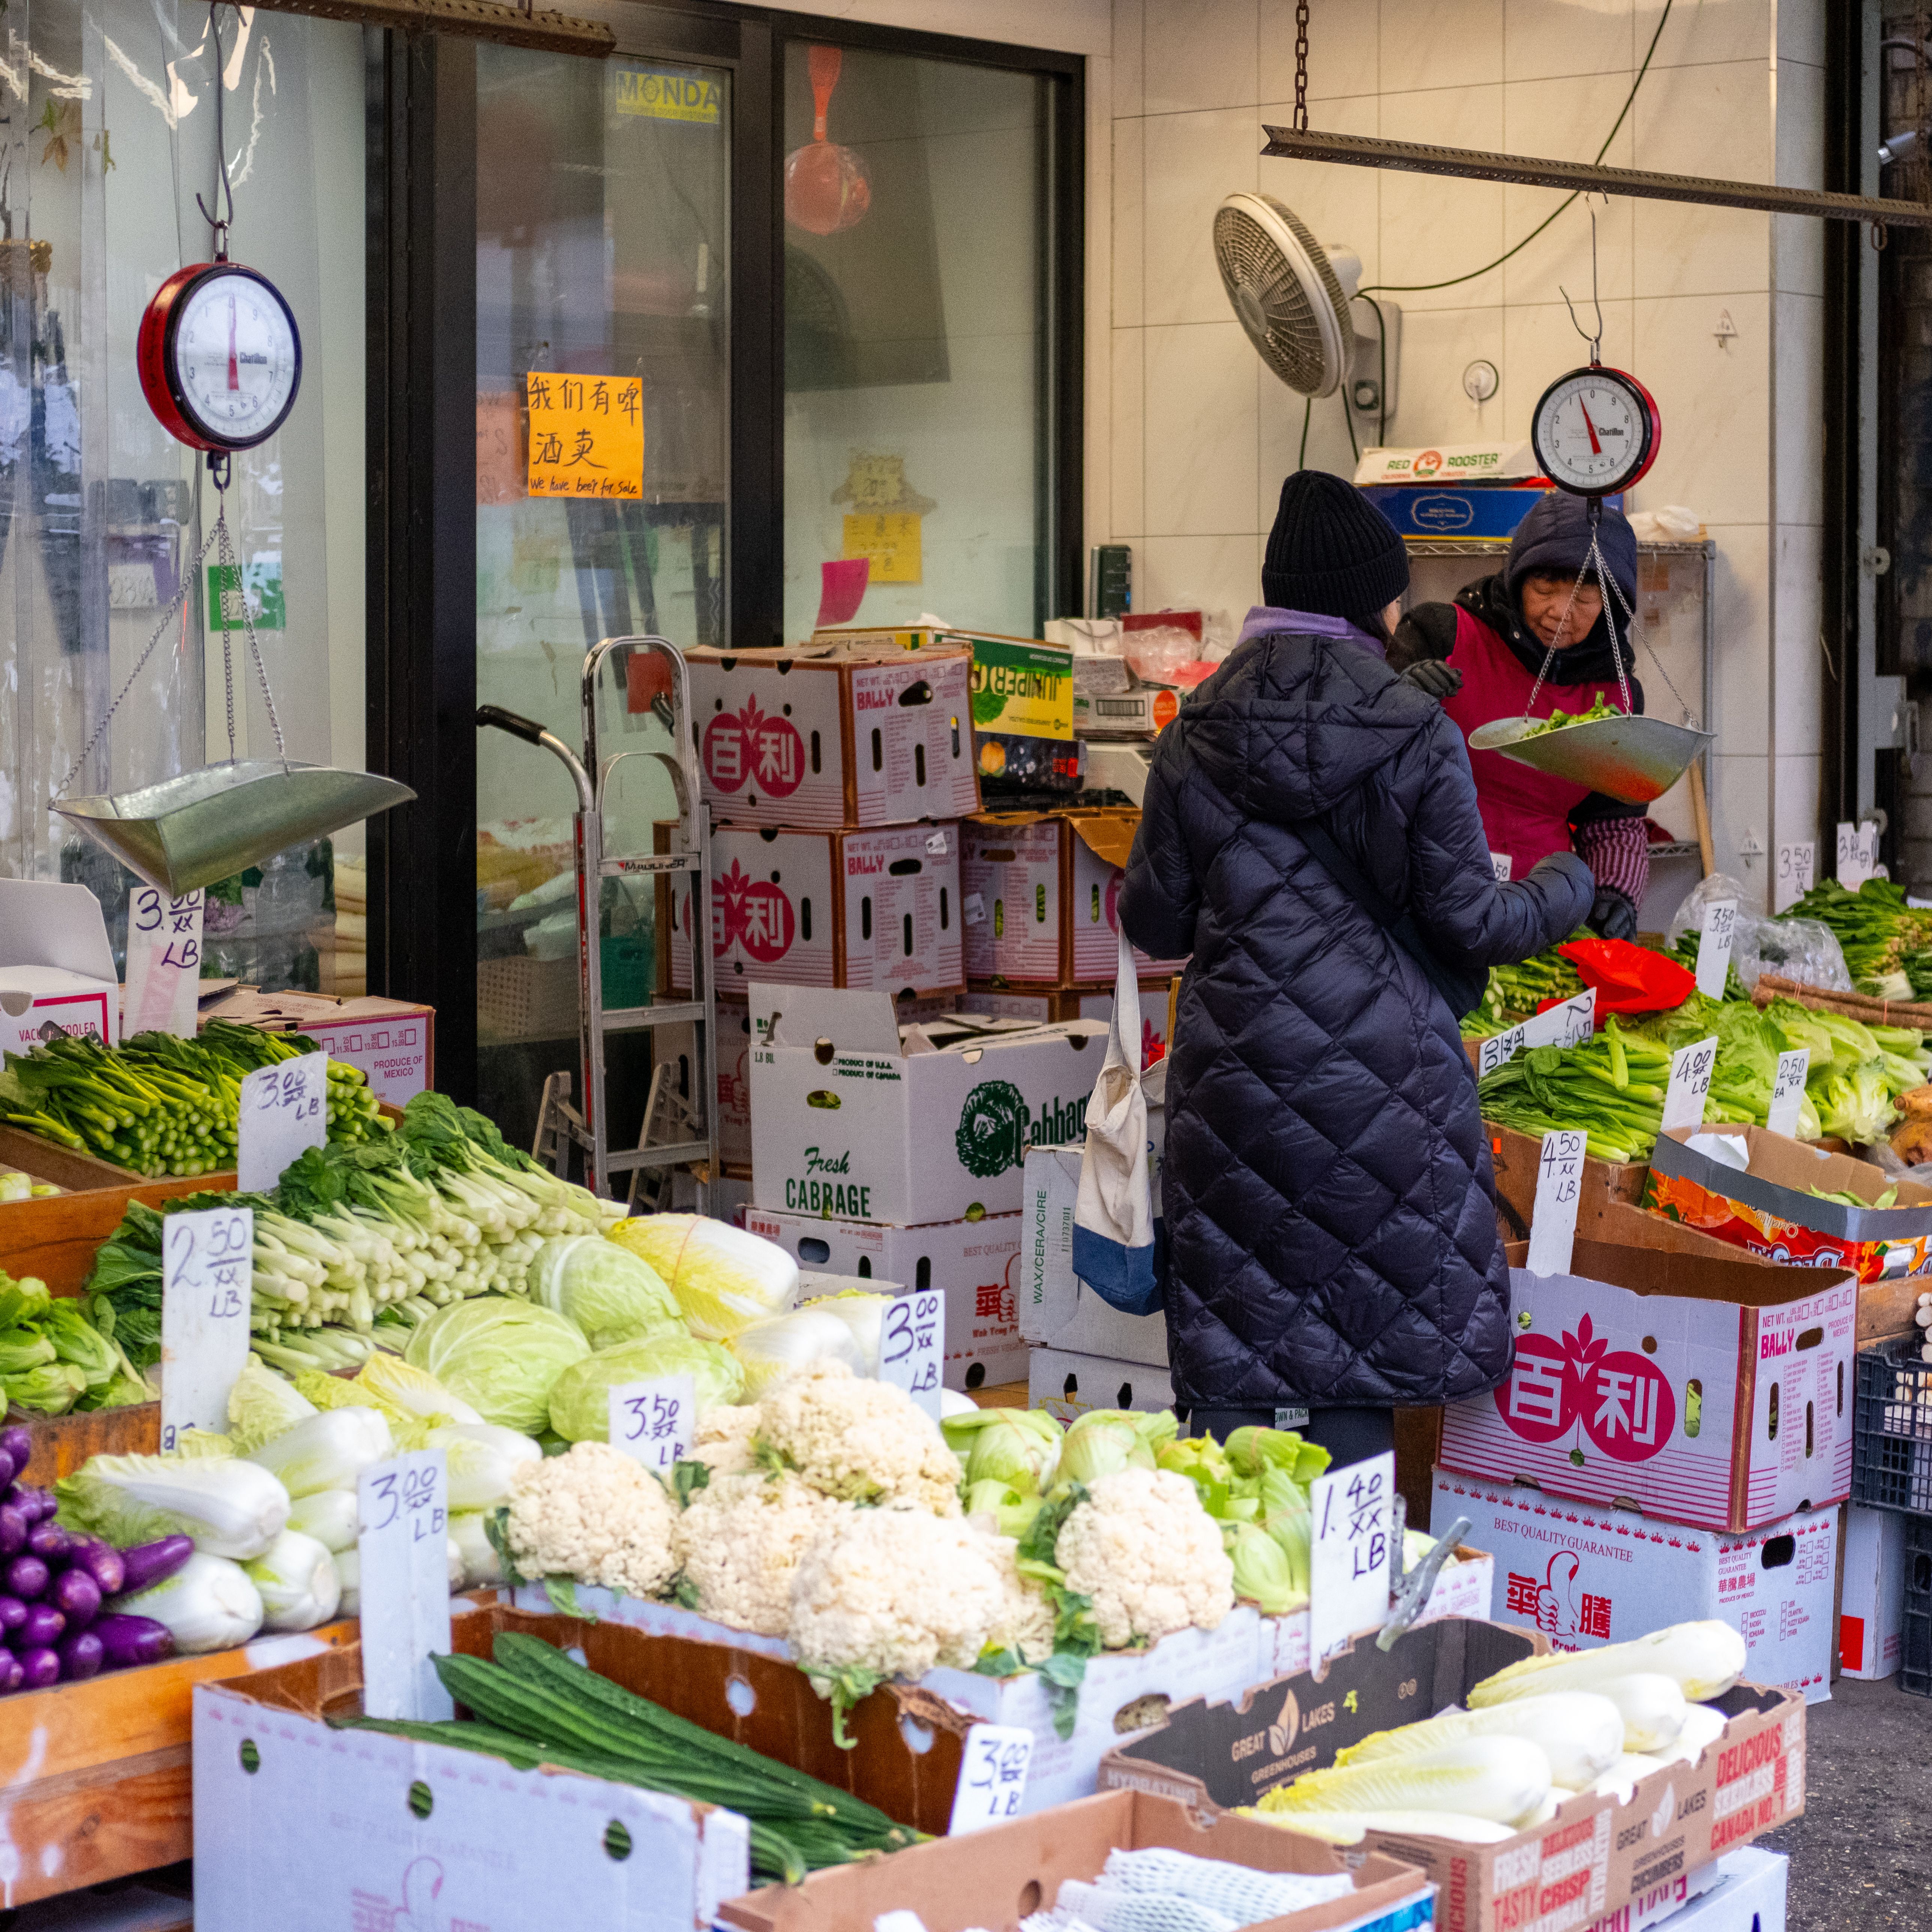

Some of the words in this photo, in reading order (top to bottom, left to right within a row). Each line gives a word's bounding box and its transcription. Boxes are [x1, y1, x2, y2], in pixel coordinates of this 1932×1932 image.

[205, 306, 209, 318] 1
[253, 309, 257, 321] 9
[189, 331, 195, 343] 2
[267, 336, 272, 347] 8
[189, 367, 195, 380] 3
[268, 371, 273, 383] 7
[205, 394, 210, 405] 4
[252, 395, 257, 408] 6
[528, 376, 639, 426] 我们有啤
[1569, 396, 1572, 406] 1
[1590, 390, 1594, 399] 0
[1611, 397, 1616, 405] 9
[230, 405, 234, 417] 5
[1556, 416, 1560, 424] 2
[1624, 415, 1629, 423] 8
[533, 428, 609, 469] 酒卖
[1555, 440, 1559, 448] 3
[1624, 440, 1629, 449] 7
[1388, 460, 1410, 470] RED
[1448, 453, 1498, 468] ROOSTER
[1568, 458, 1572, 466] 4
[1588, 465, 1593, 474] 5
[1610, 458, 1614, 466] 6
[531, 477, 545, 489] We
[549, 476, 569, 491] have
[600, 475, 614, 495] for
[857, 688, 894, 711] BALLY
[712, 728, 796, 783] 百利
[848, 855, 884, 875] BALLY
[1718, 935, 1732, 950] LB
[162, 939, 198, 968] LB
[374, 1057, 410, 1069] PRODUCE
[413, 1056, 423, 1064] OF
[384, 1067, 413, 1078] MEXICO
[838, 1058, 864, 1067] PRODUCE
[1676, 1050, 1711, 1082] 4.00
[1780, 1058, 1804, 1078] 2.50
[838, 1069, 864, 1078] PRODUCE
[875, 1072, 901, 1080] CANADA
[258, 1070, 305, 1110] 3.00
[1692, 1077, 1709, 1095] LB
[1774, 1087, 1784, 1098] EA
[296, 1098, 319, 1120] LB
[1014, 1090, 1093, 1168] Cabbag
[804, 1147, 850, 1176] Fresh
[1542, 1133, 1580, 1178] 4.50
[786, 1178, 871, 1218] CABBAGE
[1556, 1180, 1575, 1202] LB
[1755, 1211, 1798, 1238] Quality
[1033, 1190, 1046, 1304] WAX/CERA/CIRE
[210, 1290, 242, 1318] LB
[884, 1296, 938, 1365] 3.00
[1763, 1315, 1774, 1328] NET
[1776, 1313, 1785, 1326] WT.
[1828, 1315, 1848, 1329] PRODUCE
[1849, 1314, 1854, 1322] OF
[1833, 1325, 1848, 1338] MEXICO
[1761, 1328, 1794, 1360] BALLY
[910, 1362, 938, 1393] LB
[1509, 1352, 1659, 1445] 百利
[625, 1394, 680, 1440] 3.50
[1289, 1410, 1293, 1420] &
[660, 1443, 684, 1465] LB
[370, 1467, 437, 1530] 3.00
[1320, 1473, 1382, 1540] 1.40
[413, 1508, 444, 1542] LB
[1494, 1518, 1519, 1534] BEST
[1521, 1524, 1566, 1546] QUALITY
[1567, 1536, 1634, 1563] GUARANTEE
[1353, 1533, 1386, 1581] LB
[1719, 1556, 1730, 1566] BEST
[1731, 1551, 1752, 1563] QUALITY
[1718, 1563, 1746, 1575] GUARANTEE
[1719, 1595, 1736, 1604] PRODUCE
[1232, 1731, 1266, 1762] GREAT
[1302, 1701, 1335, 1732] LAKES
[1251, 1746, 1317, 1784] GREENHOUSES
[1716, 1723, 1782, 1788] DELICIOUS
[988, 1791, 1020, 1815] LB
[1617, 1819, 1647, 1851] GREAT
[1676, 1790, 1707, 1820] LAKES
[1711, 1807, 1754, 1851] CANADA
[1758, 1797, 1776, 1827] NO.
[1780, 1792, 1784, 1814] 1
[1493, 1839, 1540, 1895] FRESH
[1493, 1881, 1538, 1932] TASTY
[1540, 1869, 1590, 1915] CRISP
